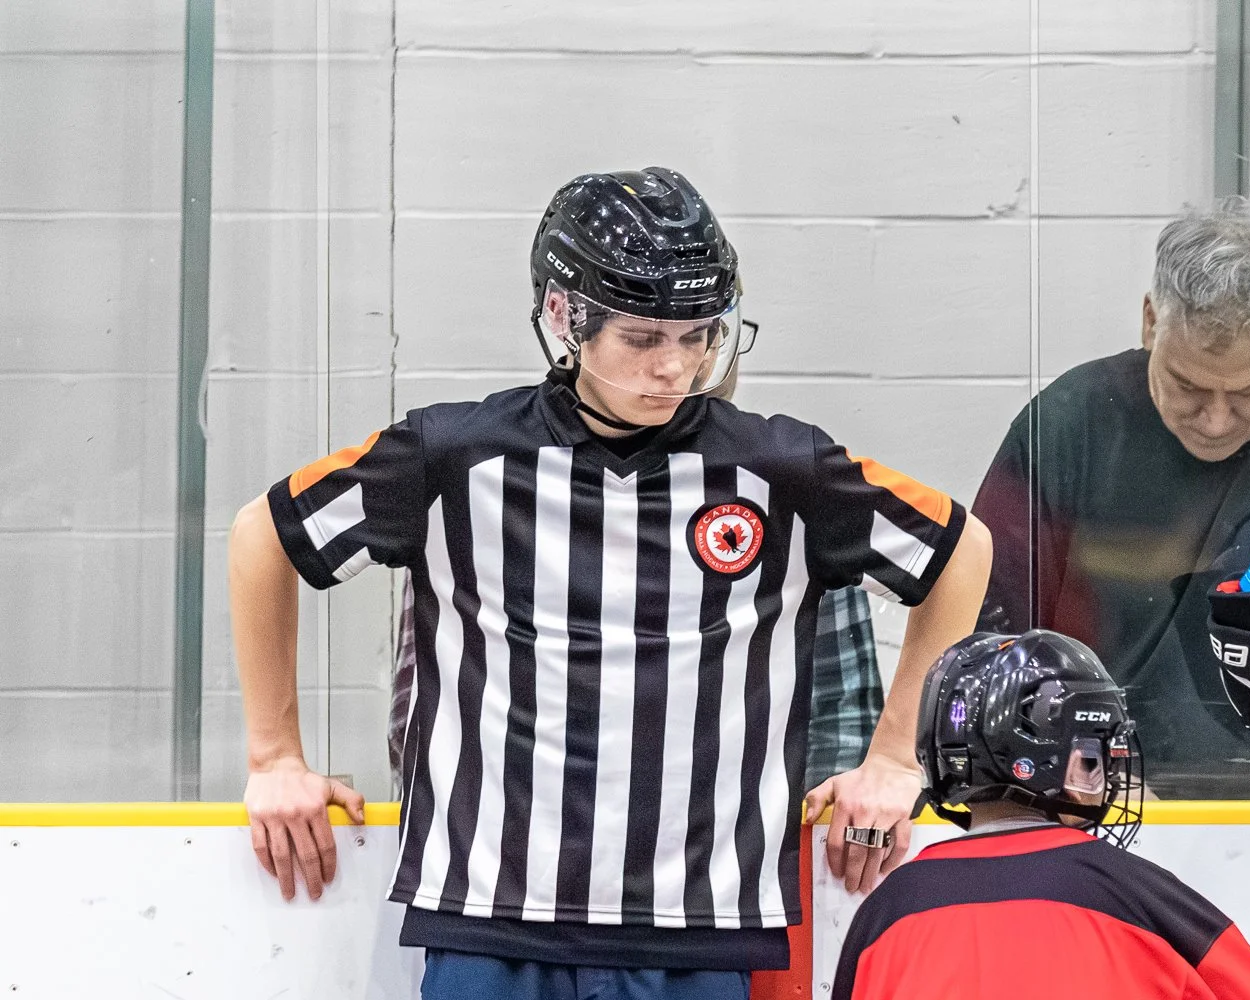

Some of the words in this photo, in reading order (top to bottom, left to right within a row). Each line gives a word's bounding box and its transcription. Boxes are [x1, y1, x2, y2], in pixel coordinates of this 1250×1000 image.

[546, 250, 575, 279] CCM
[673, 275, 718, 290] CCM
[702, 506, 758, 527] CANADA
[702, 549, 724, 570] HOCKEY
